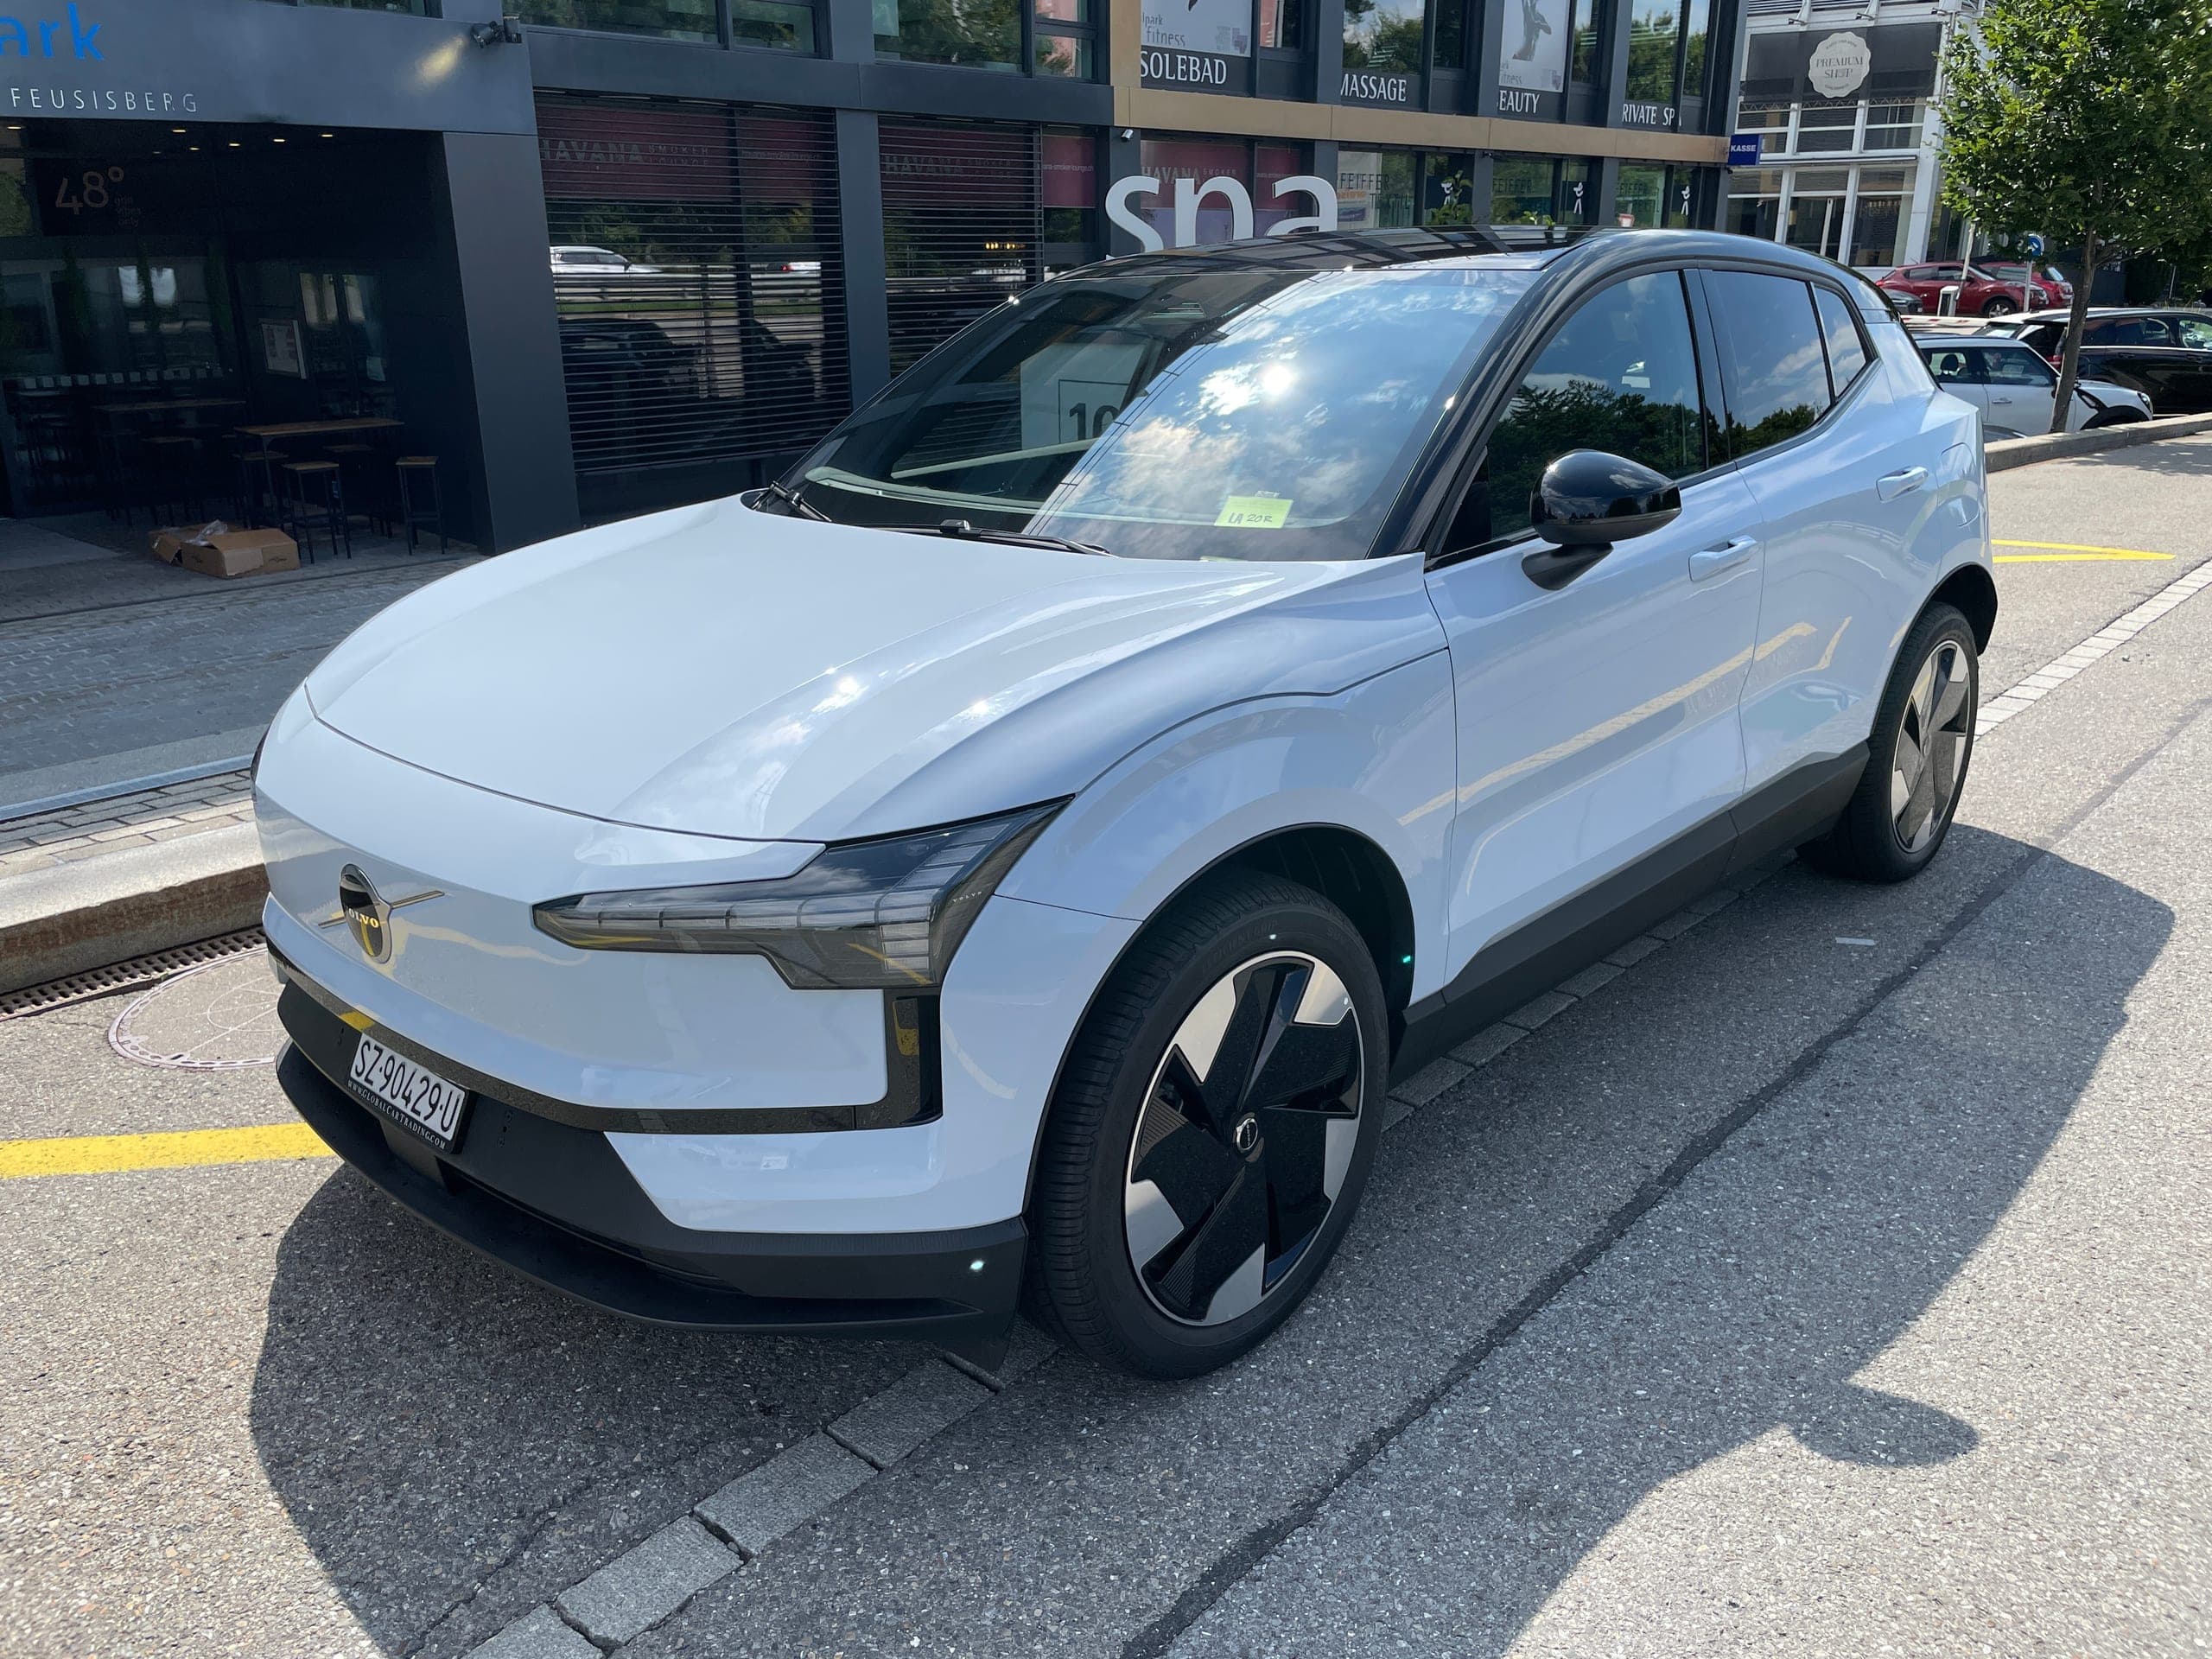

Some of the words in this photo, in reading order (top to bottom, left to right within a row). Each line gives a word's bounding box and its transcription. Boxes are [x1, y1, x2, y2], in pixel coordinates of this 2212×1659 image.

[0, 2, 105, 60] ark
[1147, 26, 1185, 47] fitness
[1140, 51, 1227, 85] SOLEBAD
[1816, 56, 1864, 67] PREMIUM
[1825, 68, 1853, 79] SHOP
[10, 87, 197, 112] FEUSISBERG
[1340, 73, 1407, 102] MASSAGE
[1497, 90, 1540, 114] EAUTY
[346, 906, 380, 928] OLVO
